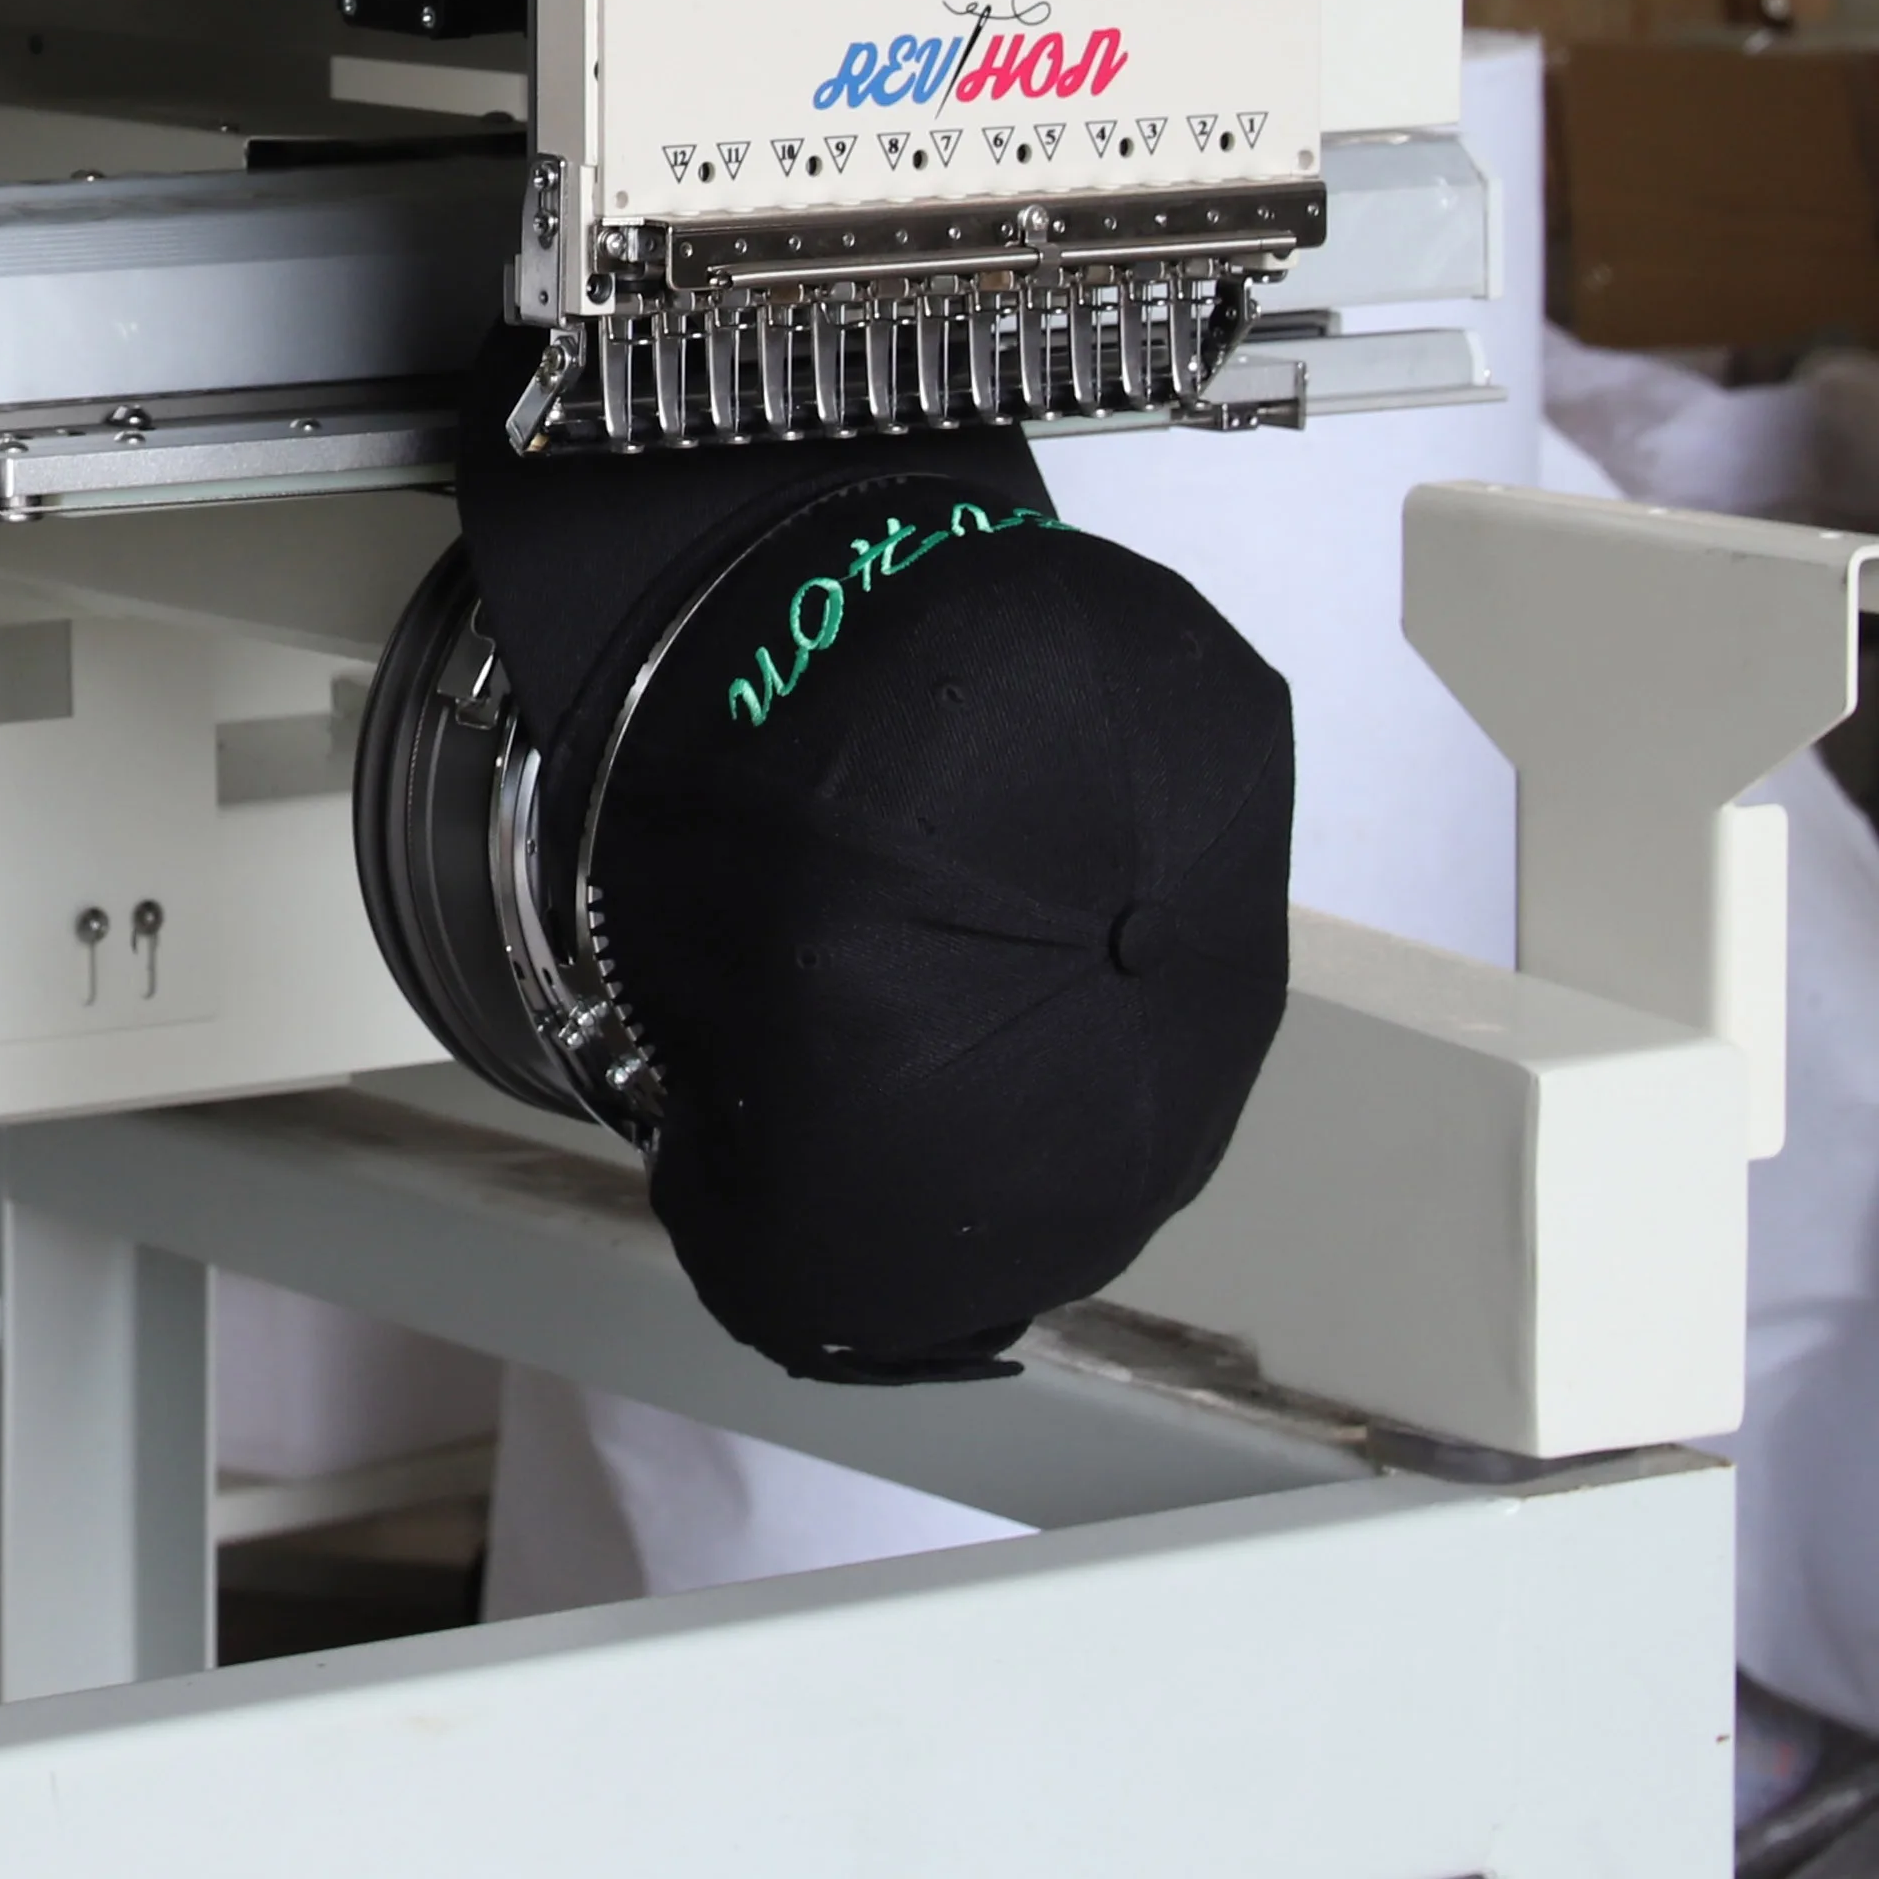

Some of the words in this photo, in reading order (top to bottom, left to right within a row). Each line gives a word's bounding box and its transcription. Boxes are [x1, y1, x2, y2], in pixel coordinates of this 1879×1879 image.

[671, 150, 687, 167] 12
[727, 147, 741, 164] 11
[781, 144, 796, 161] 10
[835, 141, 846, 157] 9
[888, 138, 899, 154] 8
[941, 136, 951, 151] 7
[993, 133, 1004, 148] 6
[1046, 130, 1056, 145] 5
[1096, 127, 1107, 142] 4
[1147, 123, 1158, 139] 3
[1198, 120, 1208, 136] 2
[1247, 118, 1255, 134] 1
